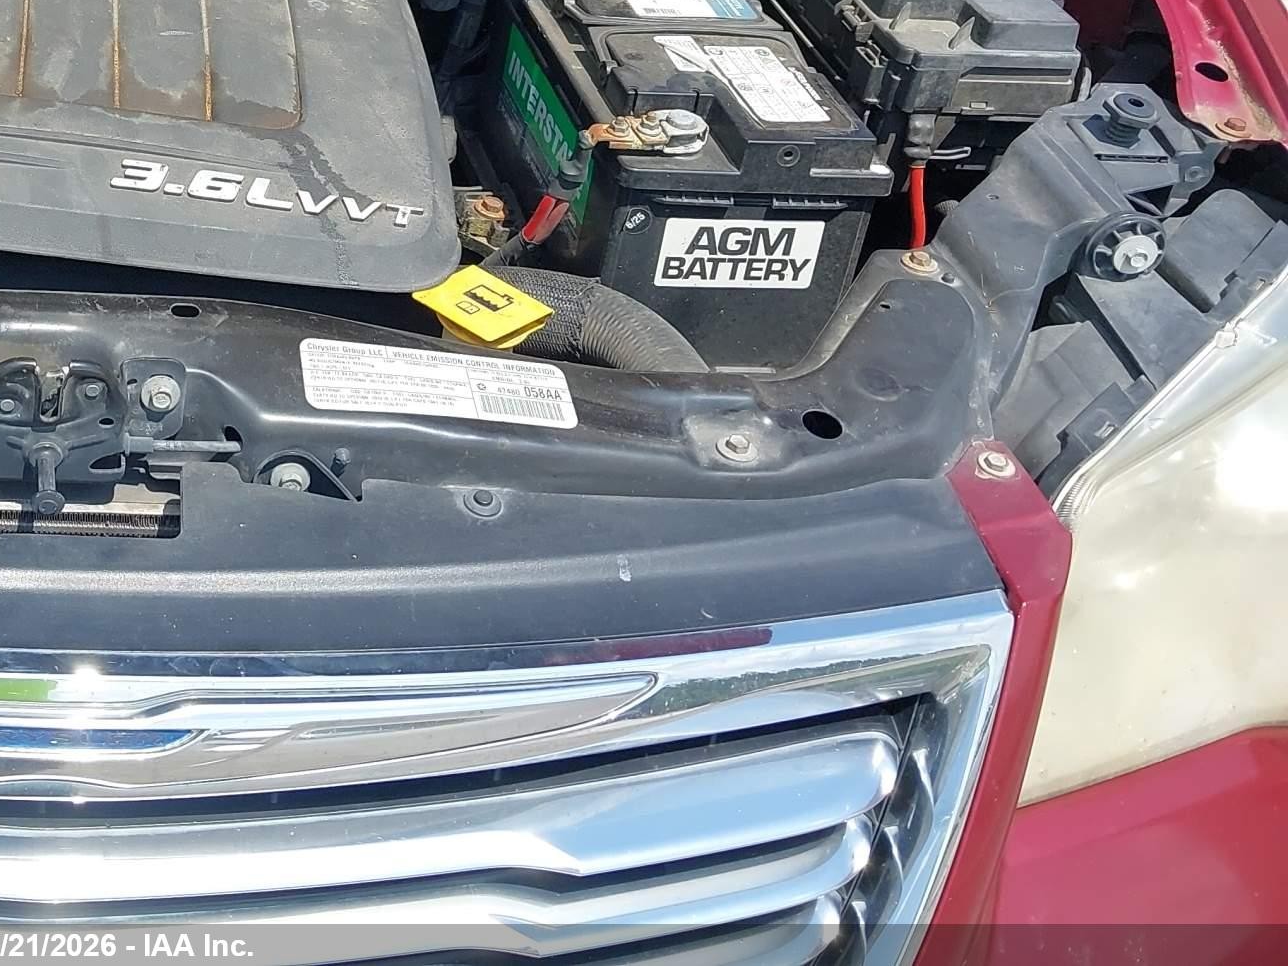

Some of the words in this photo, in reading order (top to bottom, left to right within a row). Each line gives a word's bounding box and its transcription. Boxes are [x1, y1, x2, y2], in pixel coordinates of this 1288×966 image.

[109, 158, 294, 211] 3.6L
[296, 189, 424, 228] VVT
[625, 213, 646, 230] 6/25
[685, 226, 797, 256] AGM
[661, 256, 812, 281] BATTERY
[307, 342, 339, 353] Chrysler
[342, 345, 366, 356] Group
[368, 347, 383, 357] LLC
[392, 351, 424, 361] VEHICLE
[427, 354, 463, 365] EMISSION
[465, 358, 500, 370] CONTROL
[502, 363, 556, 376] INFORMATION
